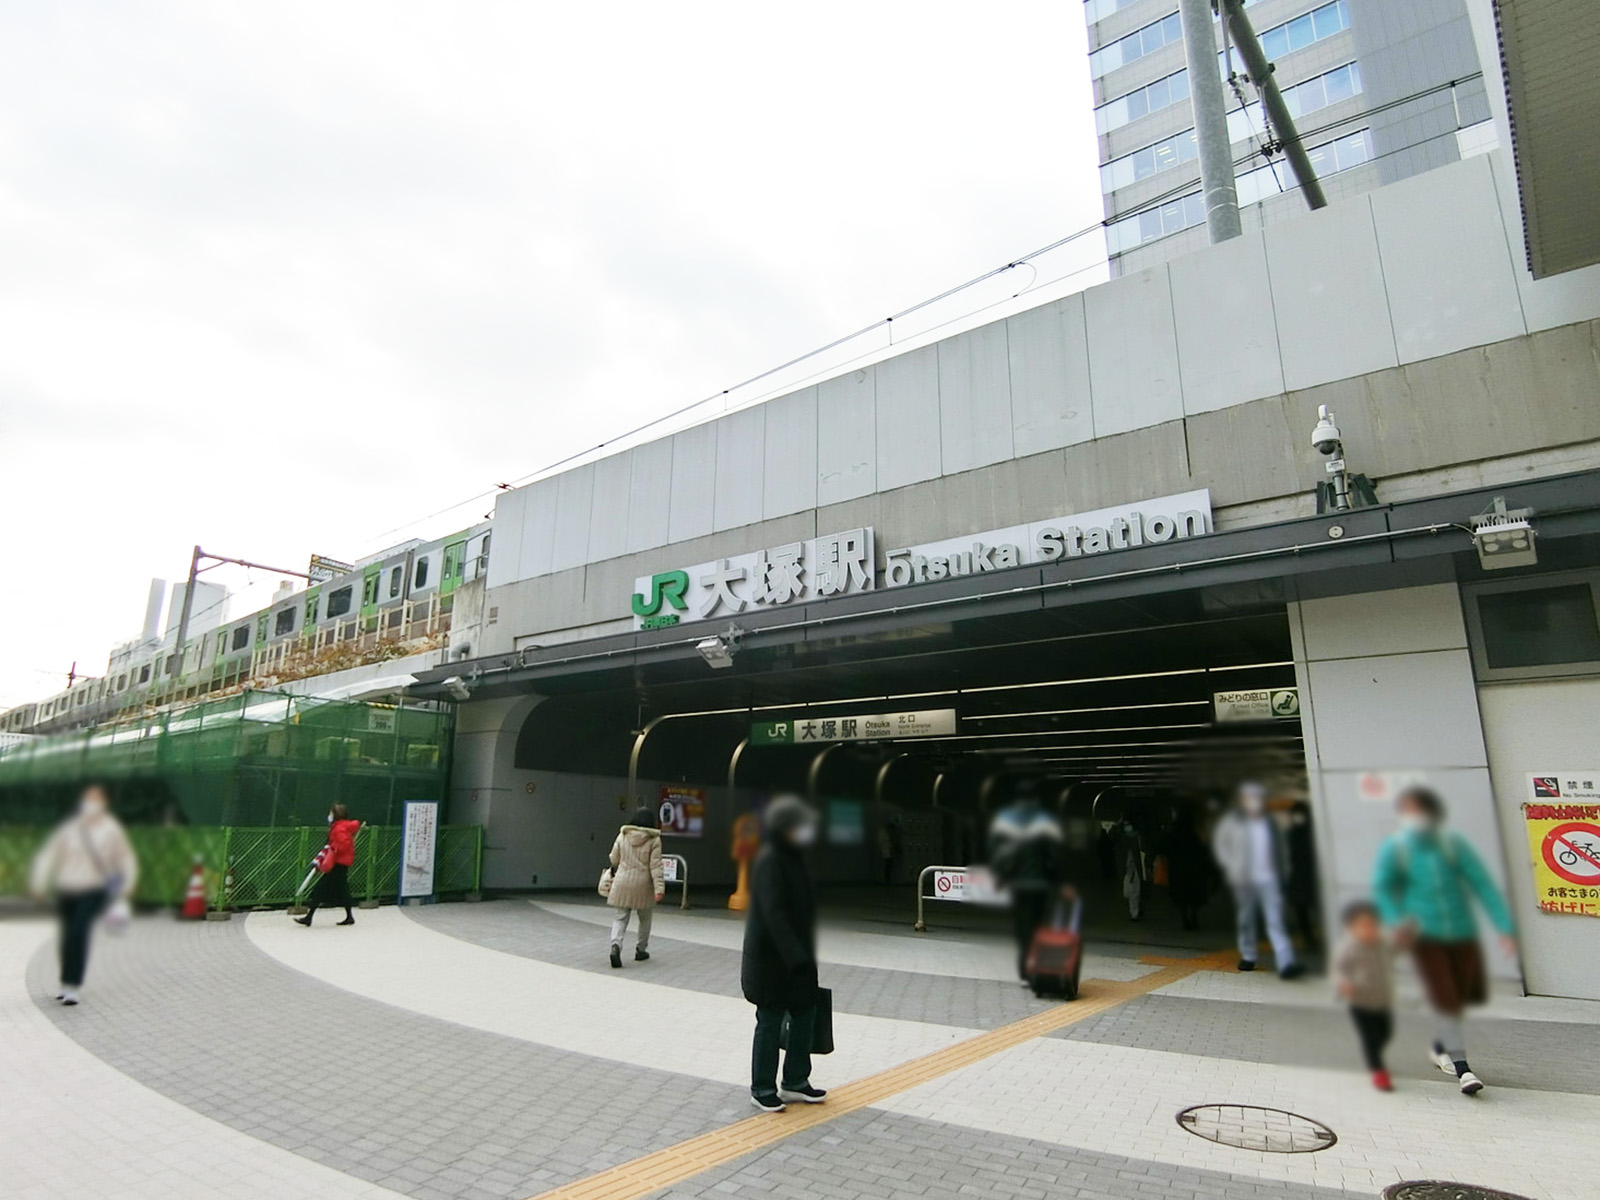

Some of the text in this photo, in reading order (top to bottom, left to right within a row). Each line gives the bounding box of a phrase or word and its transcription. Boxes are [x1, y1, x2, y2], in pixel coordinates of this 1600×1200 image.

[1036, 509, 1206, 561] Station
[700, 527, 871, 618] 大塚駅
[632, 570, 689, 616] JR
[1218, 691, 1268, 703] みどりの窓口
[898, 714, 915, 724] 北口
[768, 723, 787, 738] JR
[802, 719, 858, 740] 大塚駅
[865, 729, 891, 737] Station
[1567, 780, 1594, 790] 禁煙
[1548, 887, 1600, 899] お客さまの
